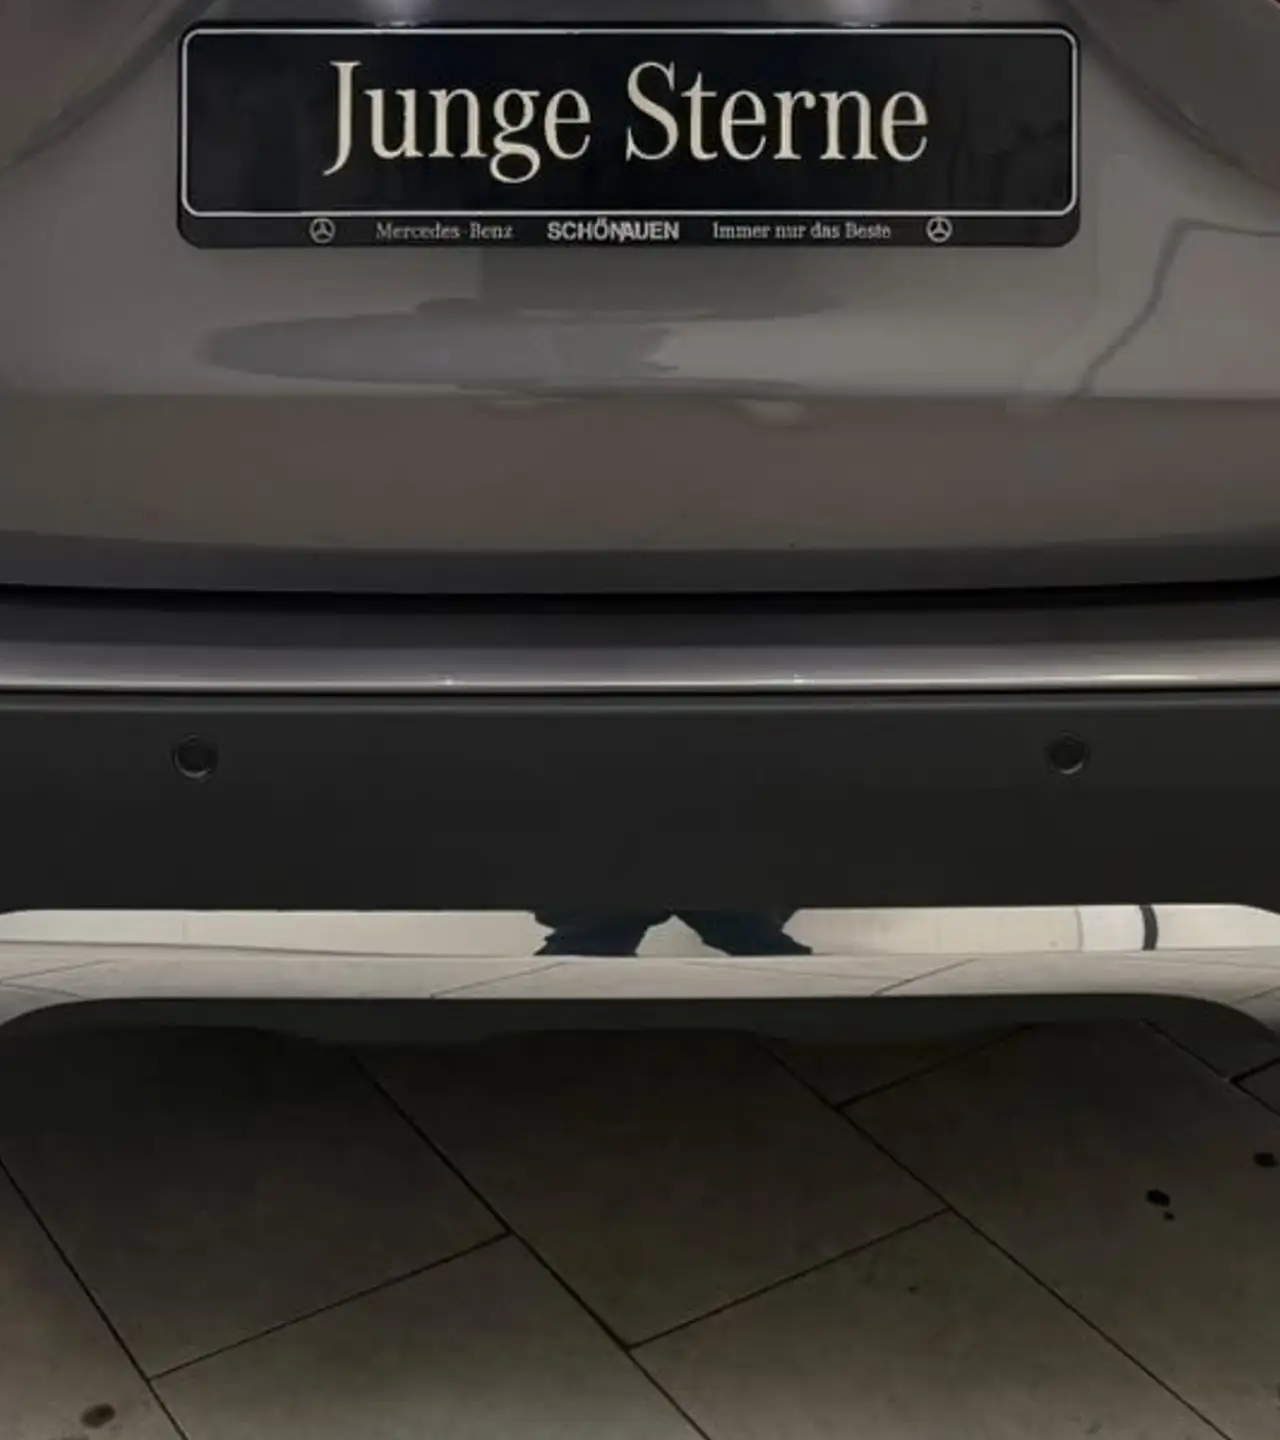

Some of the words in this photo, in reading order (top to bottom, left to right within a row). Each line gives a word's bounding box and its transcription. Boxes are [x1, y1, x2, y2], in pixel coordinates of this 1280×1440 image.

[323, 61, 592, 184] Junge
[625, 61, 929, 162] Sterne
[547, 216, 680, 243] SCHÖNAUEN
[713, 221, 770, 239] Immer
[776, 224, 806, 239] nur
[810, 221, 840, 239] das
[846, 221, 892, 239] Beste
